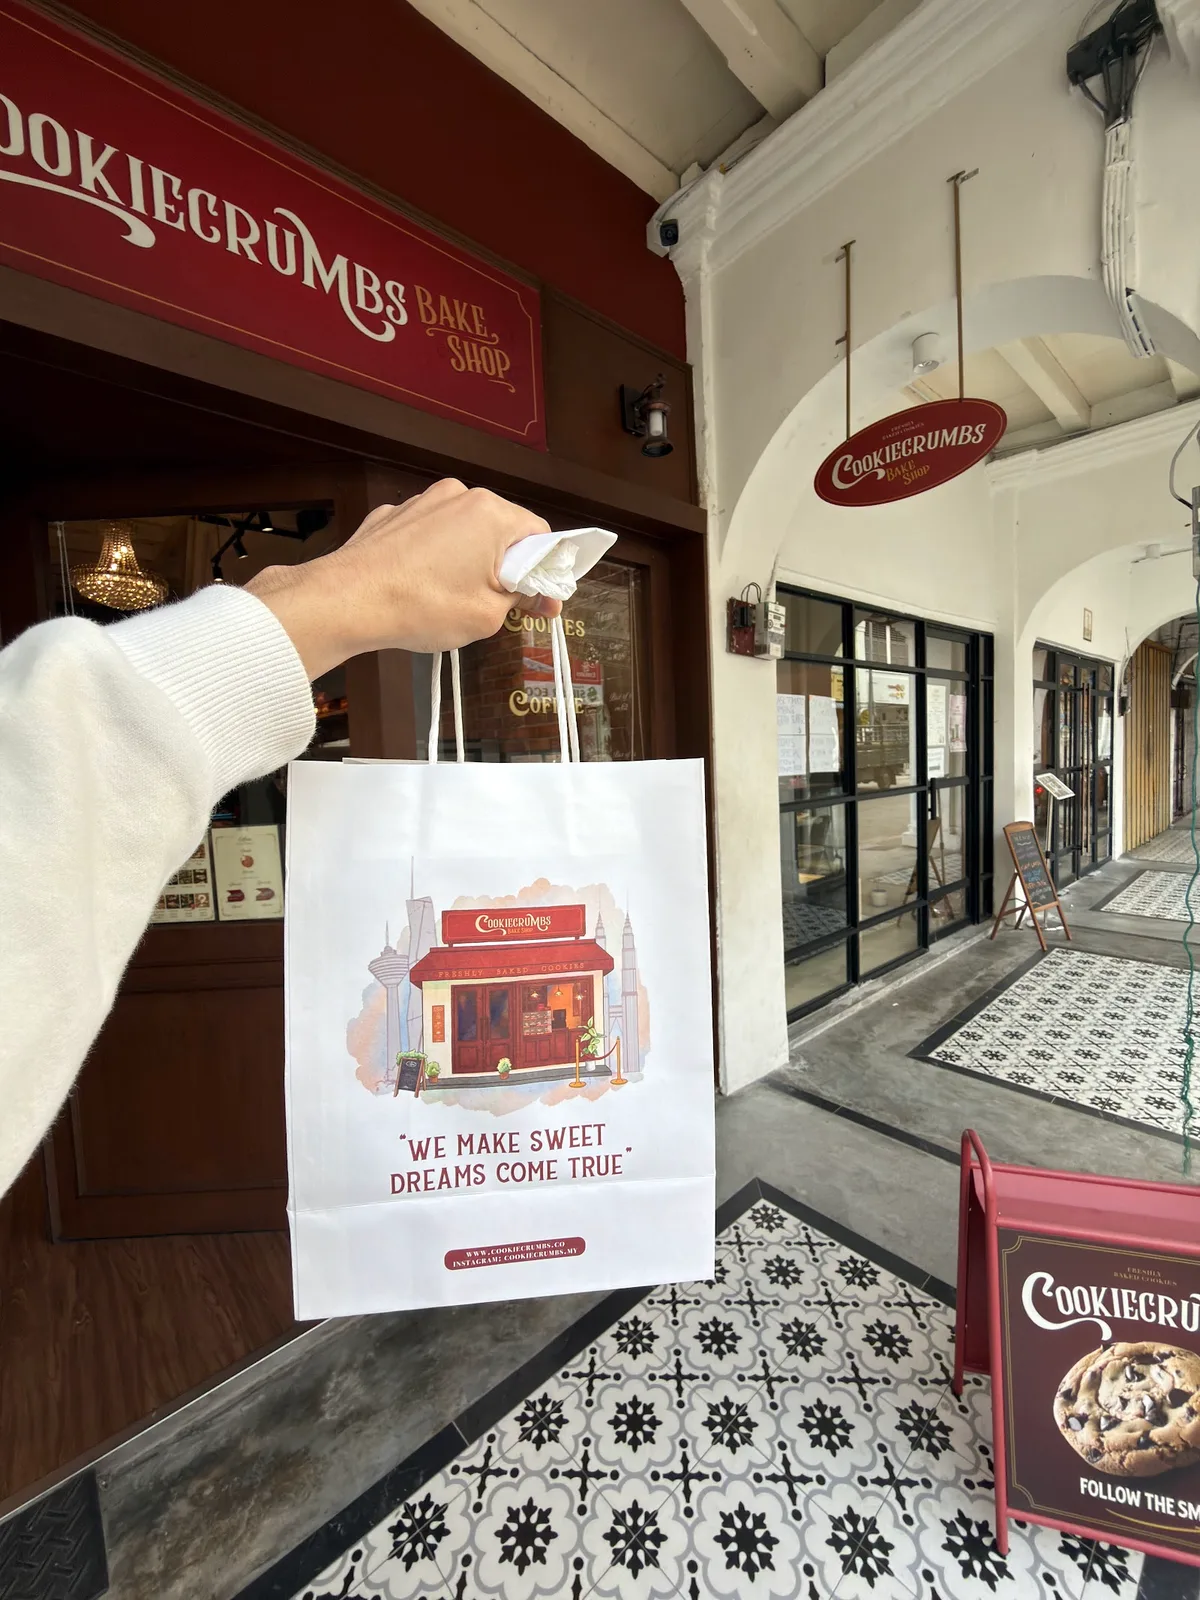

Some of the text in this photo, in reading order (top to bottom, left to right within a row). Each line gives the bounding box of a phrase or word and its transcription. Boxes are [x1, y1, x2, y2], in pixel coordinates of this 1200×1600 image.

[0, 93, 408, 342] OOKIECRUMBS
[414, 285, 495, 341] BAKE
[447, 336, 513, 386] SHOP
[831, 423, 986, 490] COOKIECRUMBS
[885, 460, 916, 482] BAKE
[903, 465, 930, 486] SHOP
[504, 608, 585, 637] COOES
[509, 690, 585, 716] COFE
[475, 914, 551, 935] COOKIECRUMBS
[438, 963, 585, 978] FRESHLY BAKED COOKIES
[456, 1132, 520, 1156] MAKE
[530, 1123, 606, 1152] SWEET
[390, 1164, 486, 1195] DREAMS
[496, 1159, 558, 1183] COME
[452, 1247, 578, 1268] INSTAGRAM: COOKIECRUMBS.MY
[465, 1241, 565, 1258] WWW.COOKIECRUMBS.CO
[1021, 1271, 1200, 1341] COOKIECRU
[1080, 1476, 1141, 1507] FOLLOW
[1144, 1492, 1176, 1516] THE
